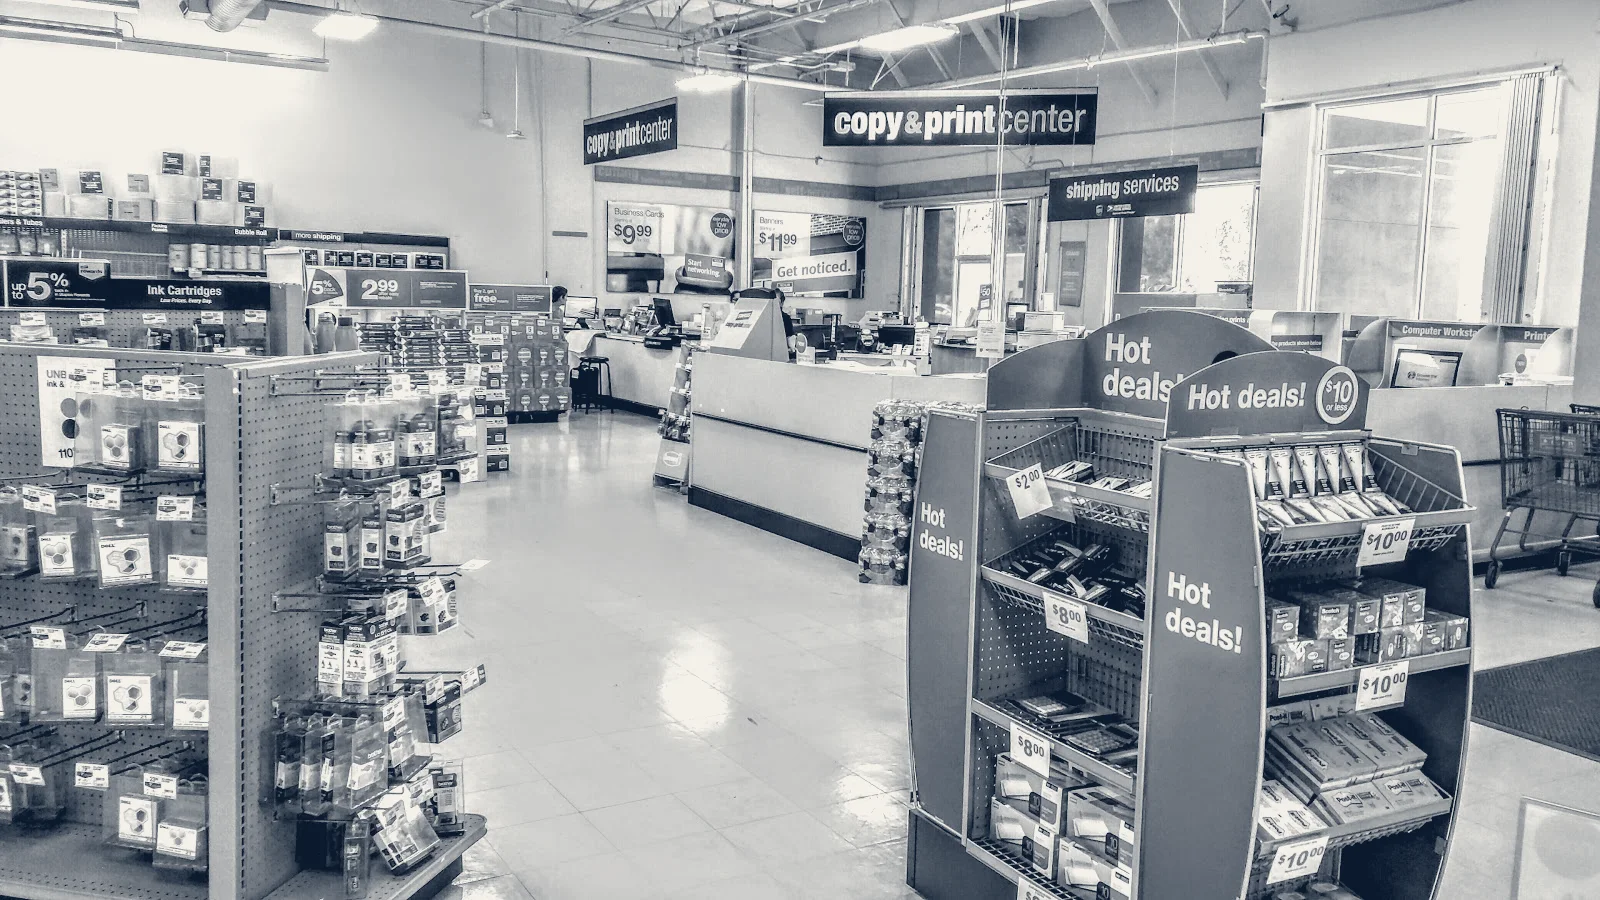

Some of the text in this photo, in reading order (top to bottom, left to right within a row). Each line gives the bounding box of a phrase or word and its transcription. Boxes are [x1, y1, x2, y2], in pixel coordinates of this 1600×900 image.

[1066, 174, 1179, 201] shipping services
[614, 207, 665, 218] Business Cards
[23, 218, 43, 226] Tubes
[759, 216, 784, 225] Banners
[234, 228, 255, 236] Bubble
[714, 227, 729, 235] price
[312, 233, 341, 242] shipping
[687, 258, 702, 267] Start
[687, 266, 720, 277] networking.
[777, 259, 851, 278] Get noticed.
[11, 283, 26, 292] up
[26, 271, 69, 301] 5%
[147, 284, 222, 298] Ink Cartridges
[11, 290, 24, 299] to
[474, 293, 497, 303] free
[1402, 325, 1442, 336] Computer
[1105, 332, 1152, 366] Hot
[1188, 382, 1307, 410] Hot deals!
[1325, 379, 1353, 404] $10
[1326, 402, 1348, 412] or less
[920, 502, 946, 529] Hot
[920, 529, 964, 561] deals!
[1167, 571, 1212, 609] Hot
[1165, 607, 1243, 654] deals!
